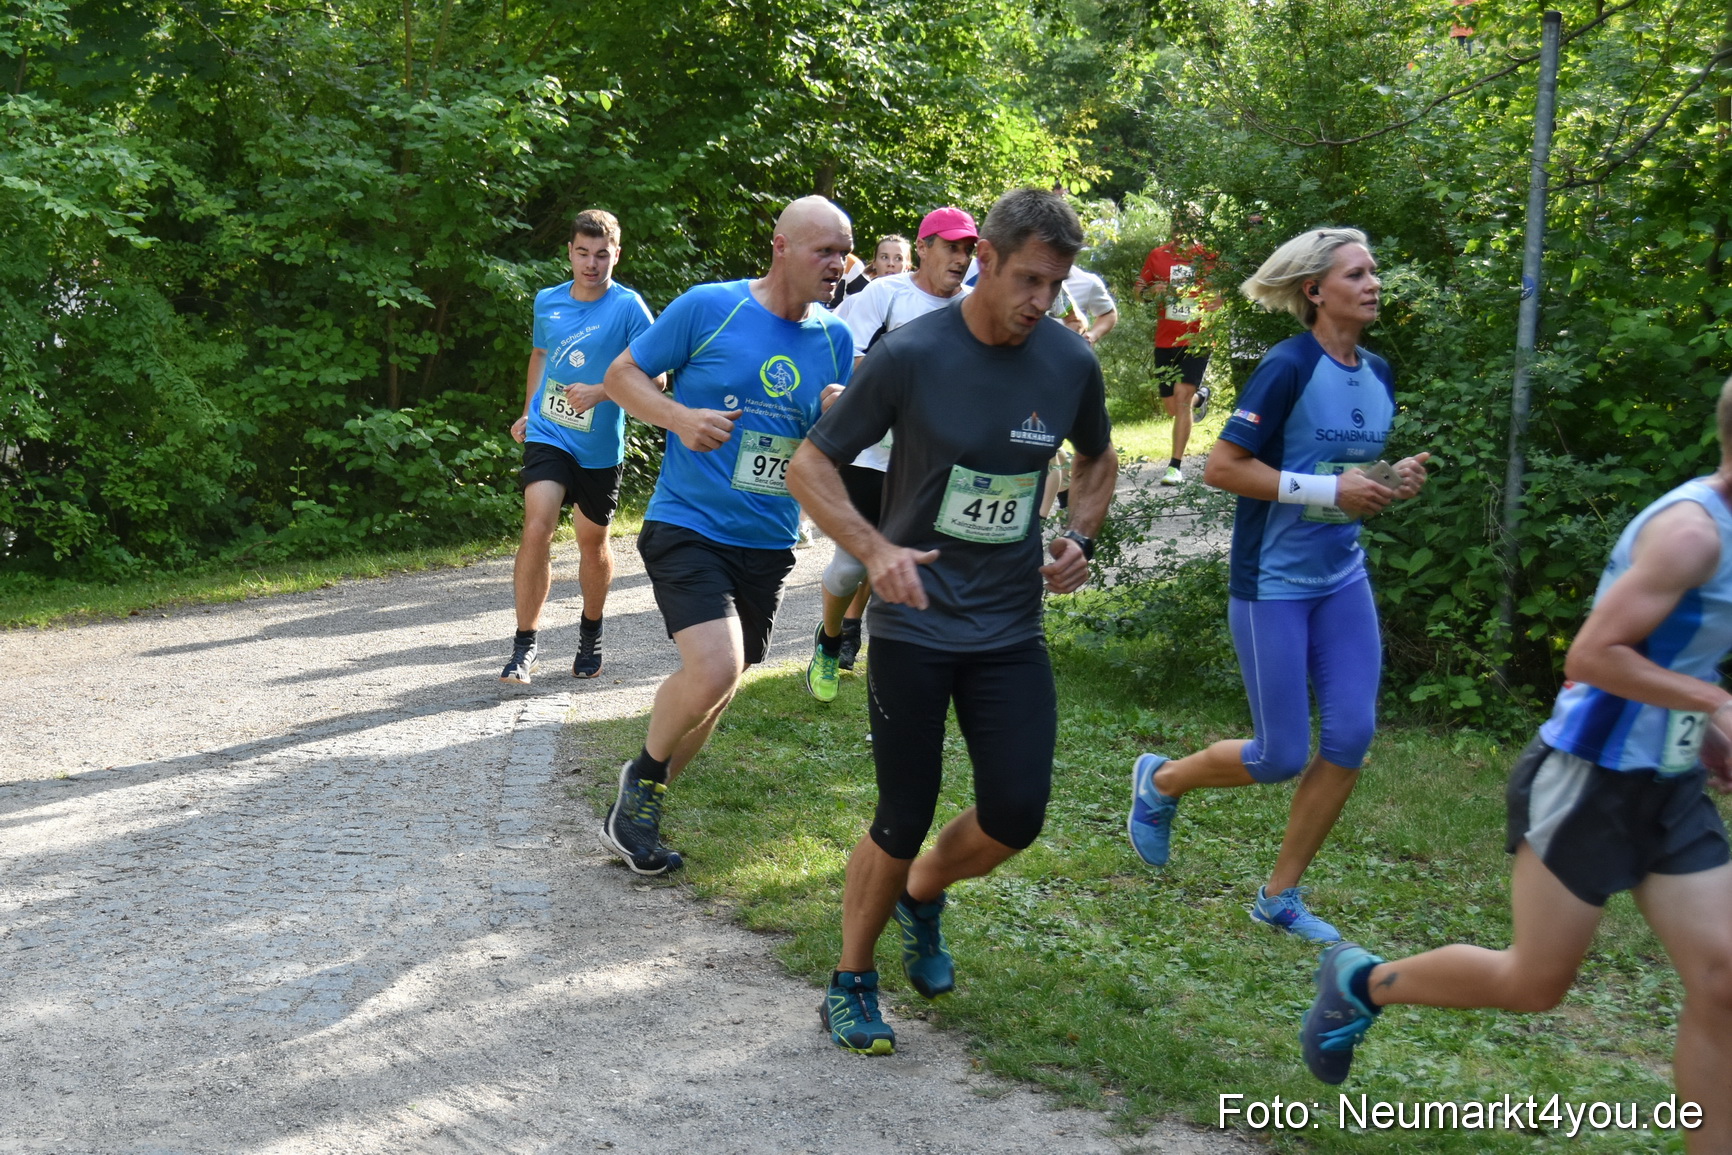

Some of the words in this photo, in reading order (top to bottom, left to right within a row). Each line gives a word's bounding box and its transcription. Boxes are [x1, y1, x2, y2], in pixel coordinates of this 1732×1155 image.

[1172, 306, 1190, 314] 543
[560, 330, 585, 347] Schick
[585, 324, 600, 333] Bau
[548, 395, 585, 420] 1532
[1010, 430, 1055, 443] BURKHARDT
[1314, 428, 1387, 443] SCHABMÜLLE
[752, 455, 790, 480] 979
[755, 477, 769, 485] Benz
[769, 479, 785, 487] Georg
[962, 498, 1017, 524] 418
